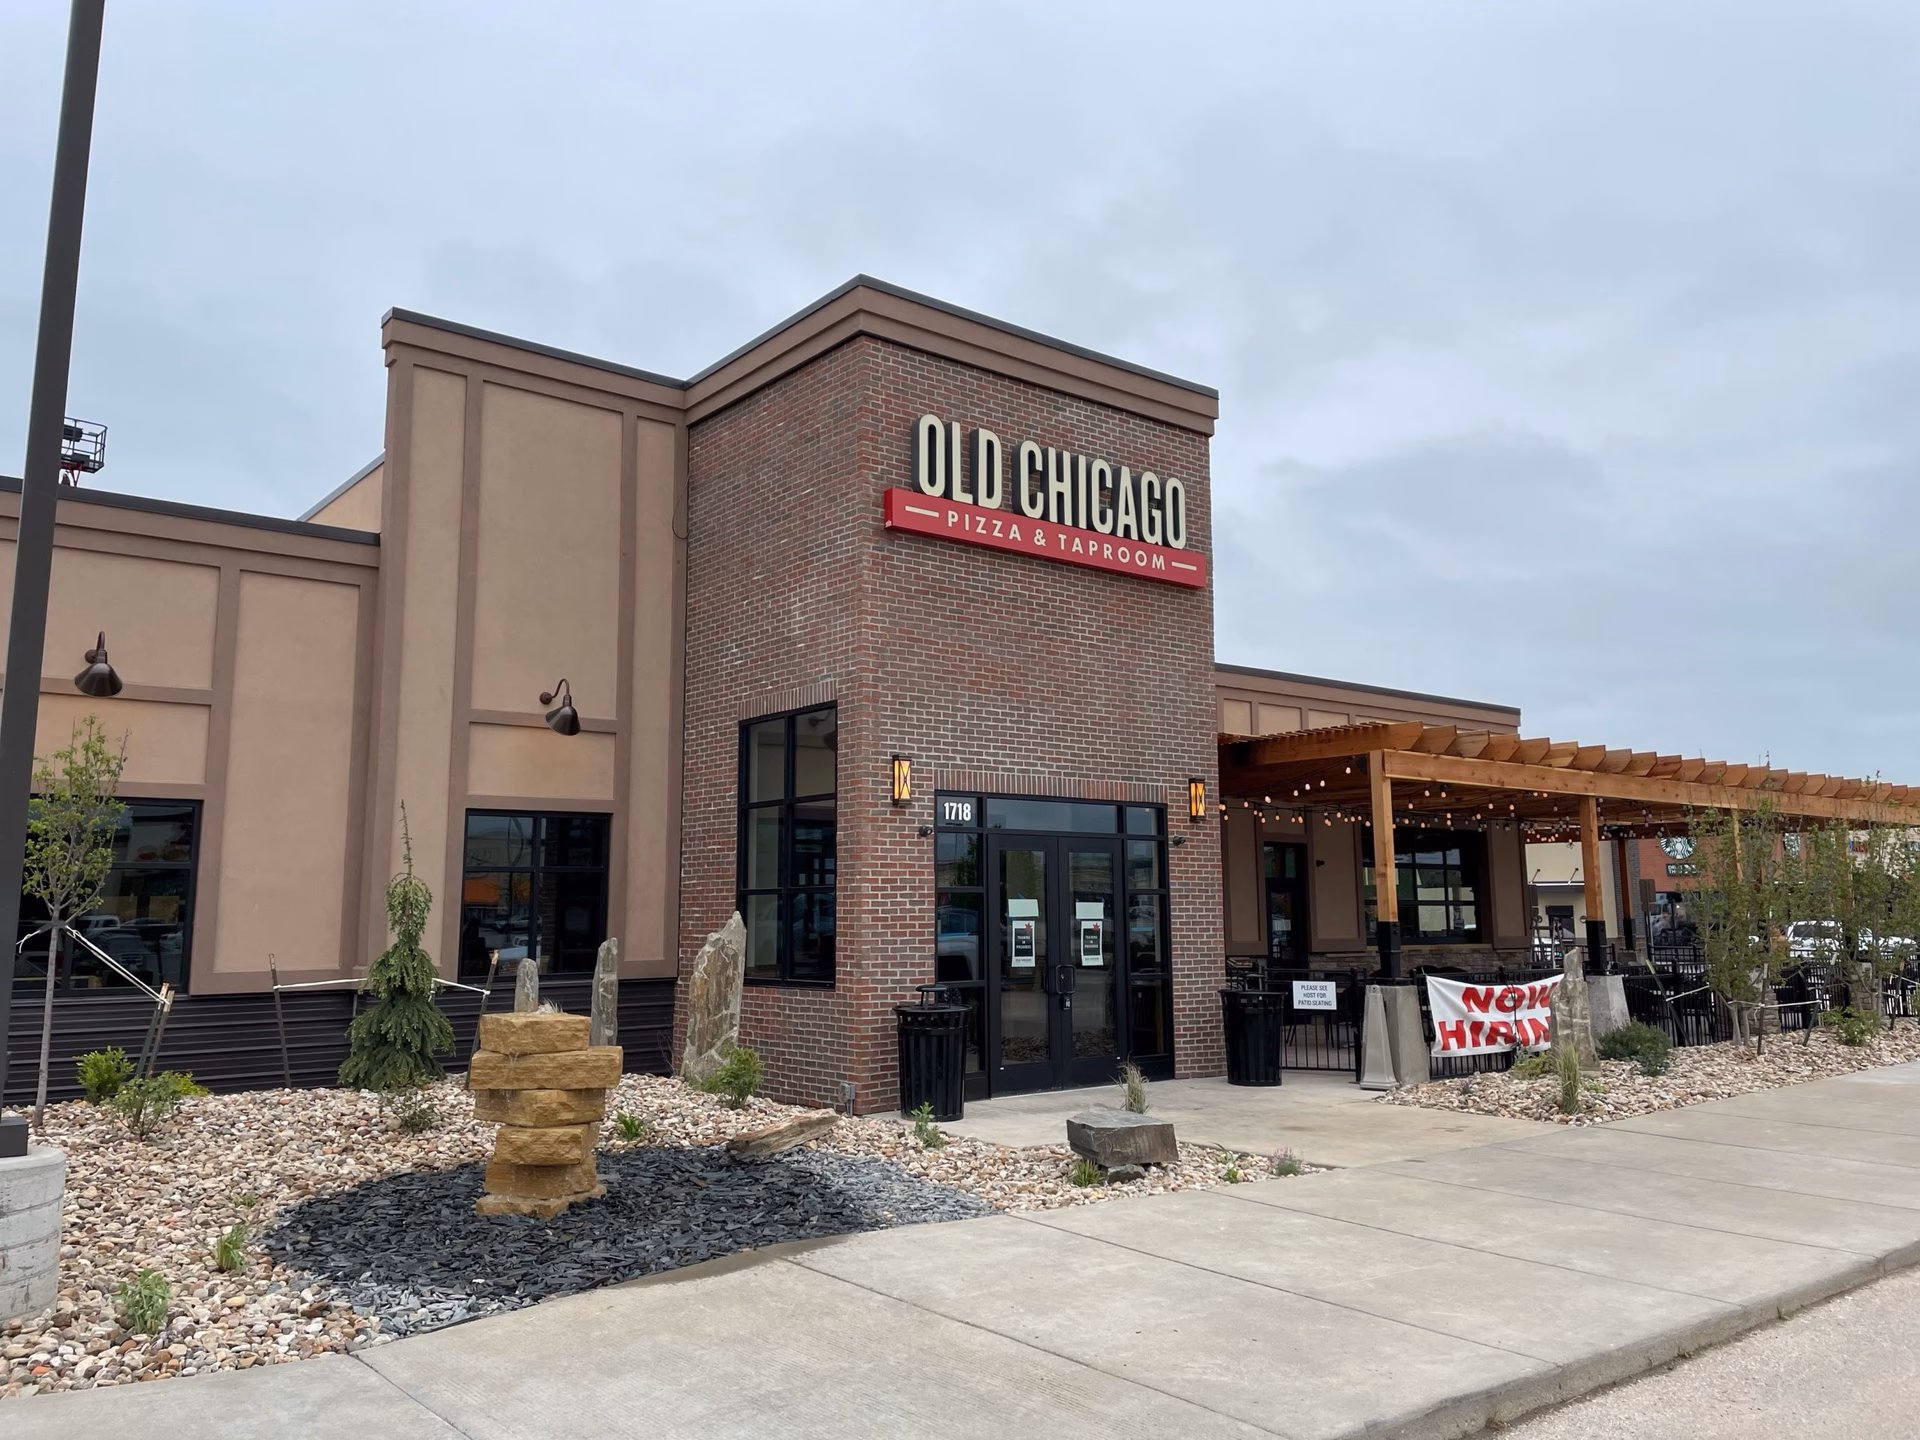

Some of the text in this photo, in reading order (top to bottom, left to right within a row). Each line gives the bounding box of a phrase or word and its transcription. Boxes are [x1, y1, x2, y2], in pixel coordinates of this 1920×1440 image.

[915, 413, 1187, 551] OLD CHICAGO
[947, 509, 1166, 571] PIZZA & TAPROOM
[943, 802, 971, 821] 1718
[1461, 981, 1559, 1014] NOW
[1438, 1016, 1551, 1051] HIRIN
